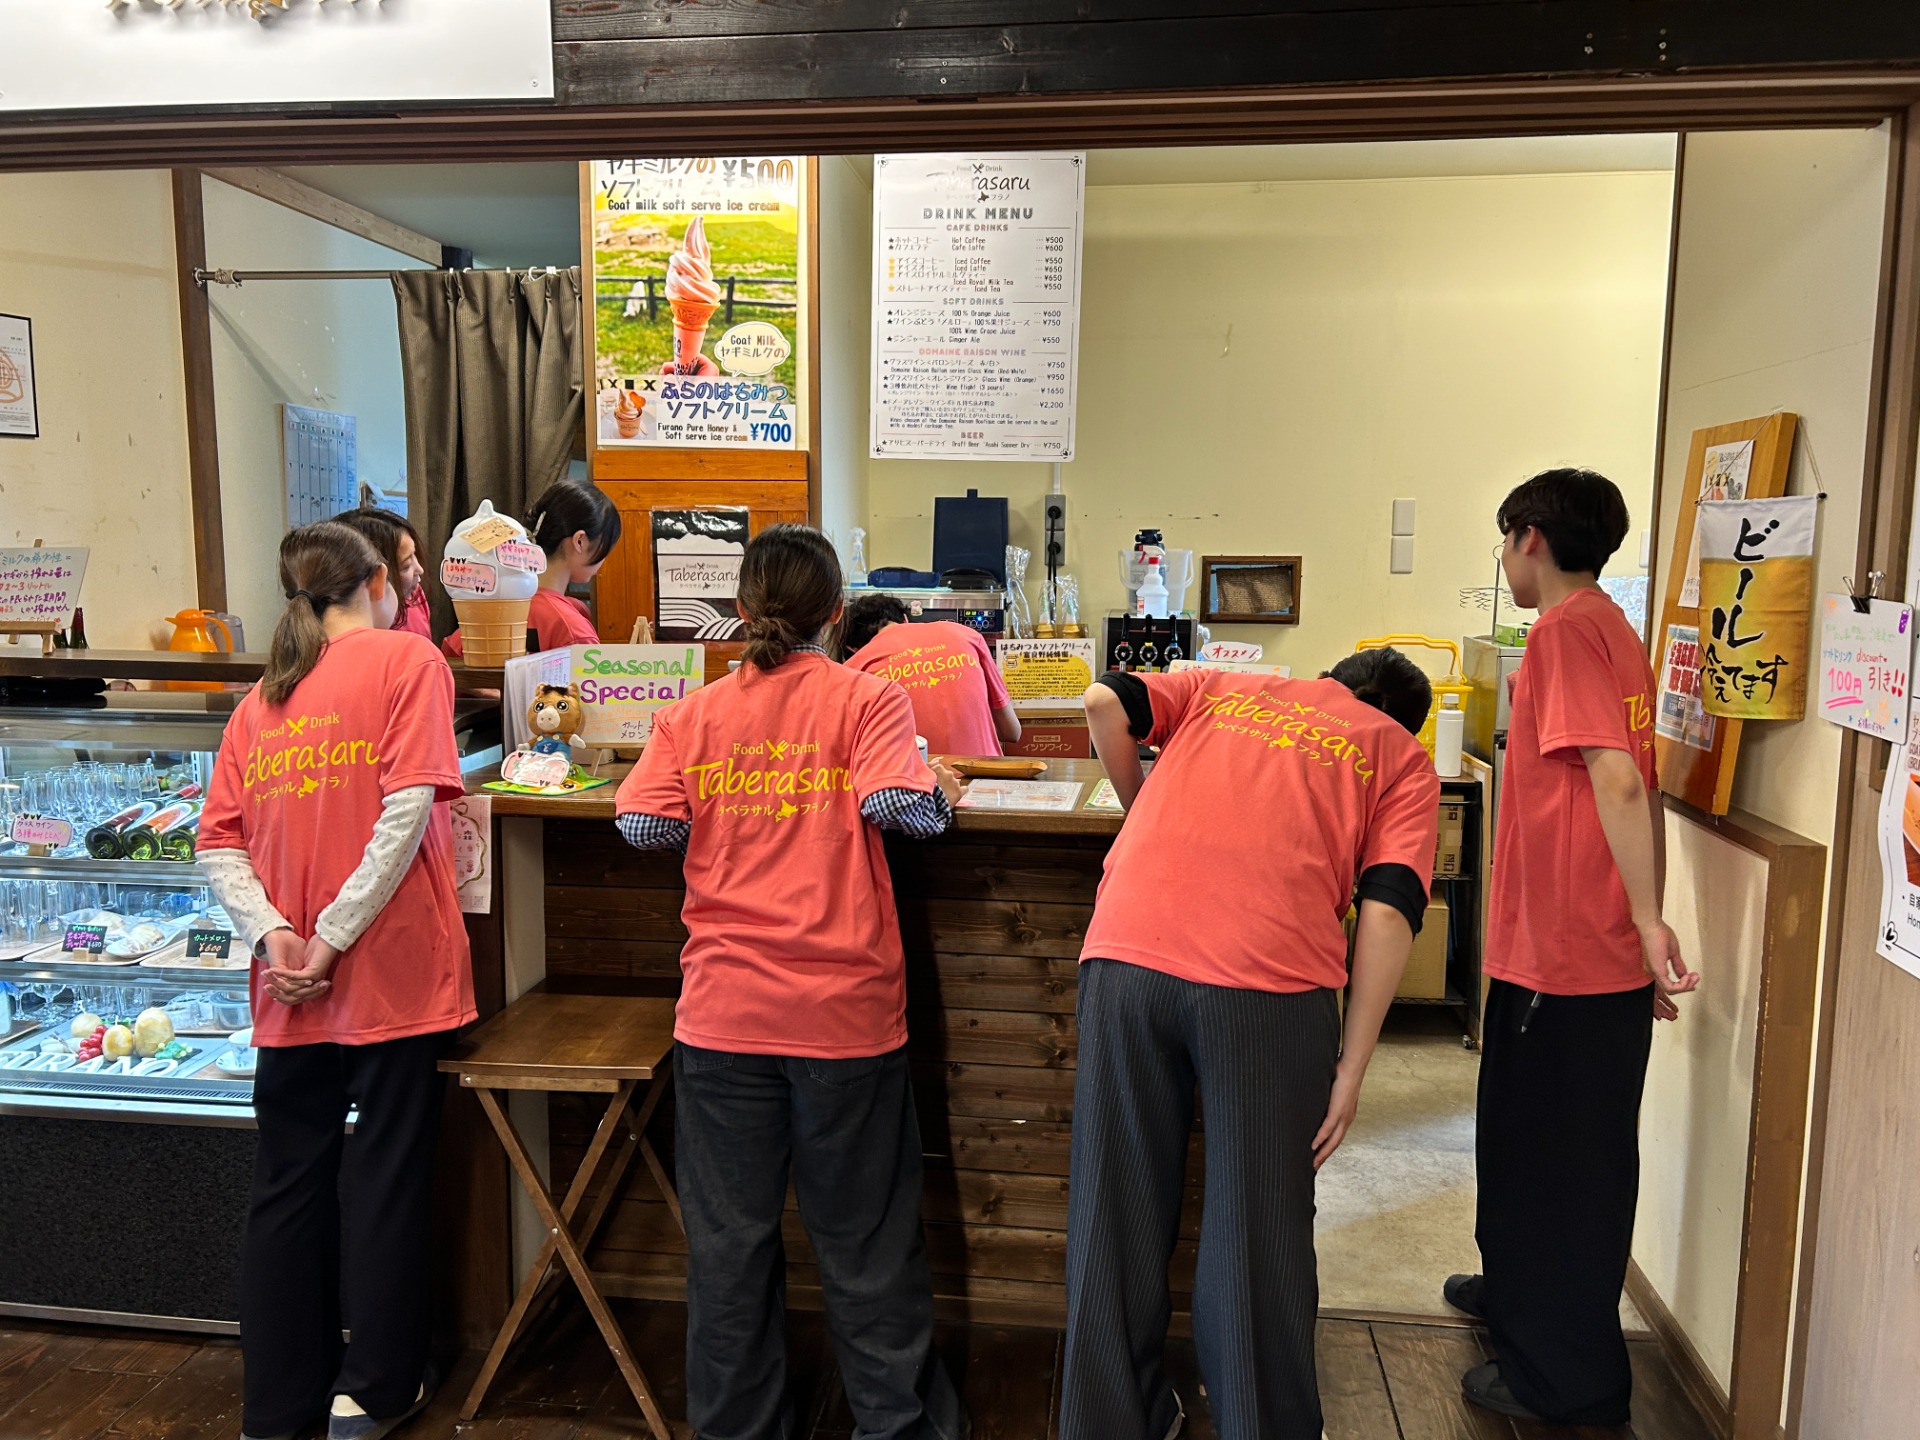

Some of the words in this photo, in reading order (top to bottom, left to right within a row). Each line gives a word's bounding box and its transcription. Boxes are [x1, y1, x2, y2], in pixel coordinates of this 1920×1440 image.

[723, 159, 794, 190] ¥500
[608, 199, 630, 211] Goat
[636, 199, 657, 210] milk
[663, 200, 685, 211] soft
[691, 202, 721, 211] serve
[727, 200, 743, 211] ice
[748, 202, 780, 211] cream
[923, 207, 977, 221] DRINK
[985, 207, 1034, 221] MENU
[946, 224, 971, 232] CAFE
[974, 224, 1009, 232] DRINKS
[1045, 236, 1064, 244] ¥500
[1045, 244, 1064, 252] ¥600
[954, 257, 968, 265] Iced
[970, 257, 991, 265] Coffee
[1044, 257, 1063, 265] ¥550
[1044, 265, 1063, 273] ¥650
[953, 278, 967, 286] Iced
[988, 278, 1001, 286] Milk
[1003, 278, 1014, 286] Tea
[1044, 274, 1063, 282] ¥650
[1043, 283, 1062, 291] ¥550
[943, 298, 968, 306] SOFT
[969, 298, 1005, 306] DRINKS
[970, 310, 992, 318] Orange
[1043, 310, 1062, 318] ¥600
[1043, 319, 1061, 327] ¥750
[730, 335, 751, 345] Goat
[756, 335, 776, 346] Milk
[948, 336, 968, 344] Ginger
[970, 336, 981, 344] Ale
[1042, 336, 1061, 344] ¥550
[720, 346, 785, 359] ヤギミルクの
[918, 348, 961, 356] DOMAINE
[963, 348, 998, 356] RAISON
[1001, 349, 1027, 357] WINE
[1047, 361, 1066, 369] ¥750
[1046, 373, 1065, 381] ¥950
[661, 381, 789, 402] ふらのはちみつ
[1039, 401, 1064, 409] ¥2,200
[666, 401, 788, 421] ソフトクリーム
[657, 422, 683, 432] Furano
[686, 423, 704, 432] Pure
[707, 424, 729, 433] Honey
[750, 423, 792, 442] ¥700
[665, 431, 681, 440] Soft
[685, 433, 707, 441] serve
[710, 432, 722, 441] ice
[725, 434, 748, 442] cream
[961, 432, 985, 440] BEER
[1043, 442, 1061, 450] ¥750
[665, 567, 738, 582] Taberasaru
[1711, 517, 1780, 649] ビール
[888, 650, 908, 663] Food
[924, 642, 948, 654] Drink
[582, 648, 695, 676] Seasonal
[1828, 667, 1863, 696] 100円
[579, 677, 686, 705] Special
[1257, 689, 1291, 708] Food
[1314, 711, 1352, 729] Drink
[260, 723, 285, 742] Food
[310, 711, 340, 729] Drink
[620, 730, 646, 739] メロン
[1204, 691, 1374, 786] Taberasaru
[733, 742, 764, 756] Food
[791, 740, 820, 756] Drink
[1297, 743, 1333, 767] フラノ
[683, 757, 854, 801] Taberasaru
[800, 800, 830, 815] フラノ
[199, 943, 222, 952] ¥600
